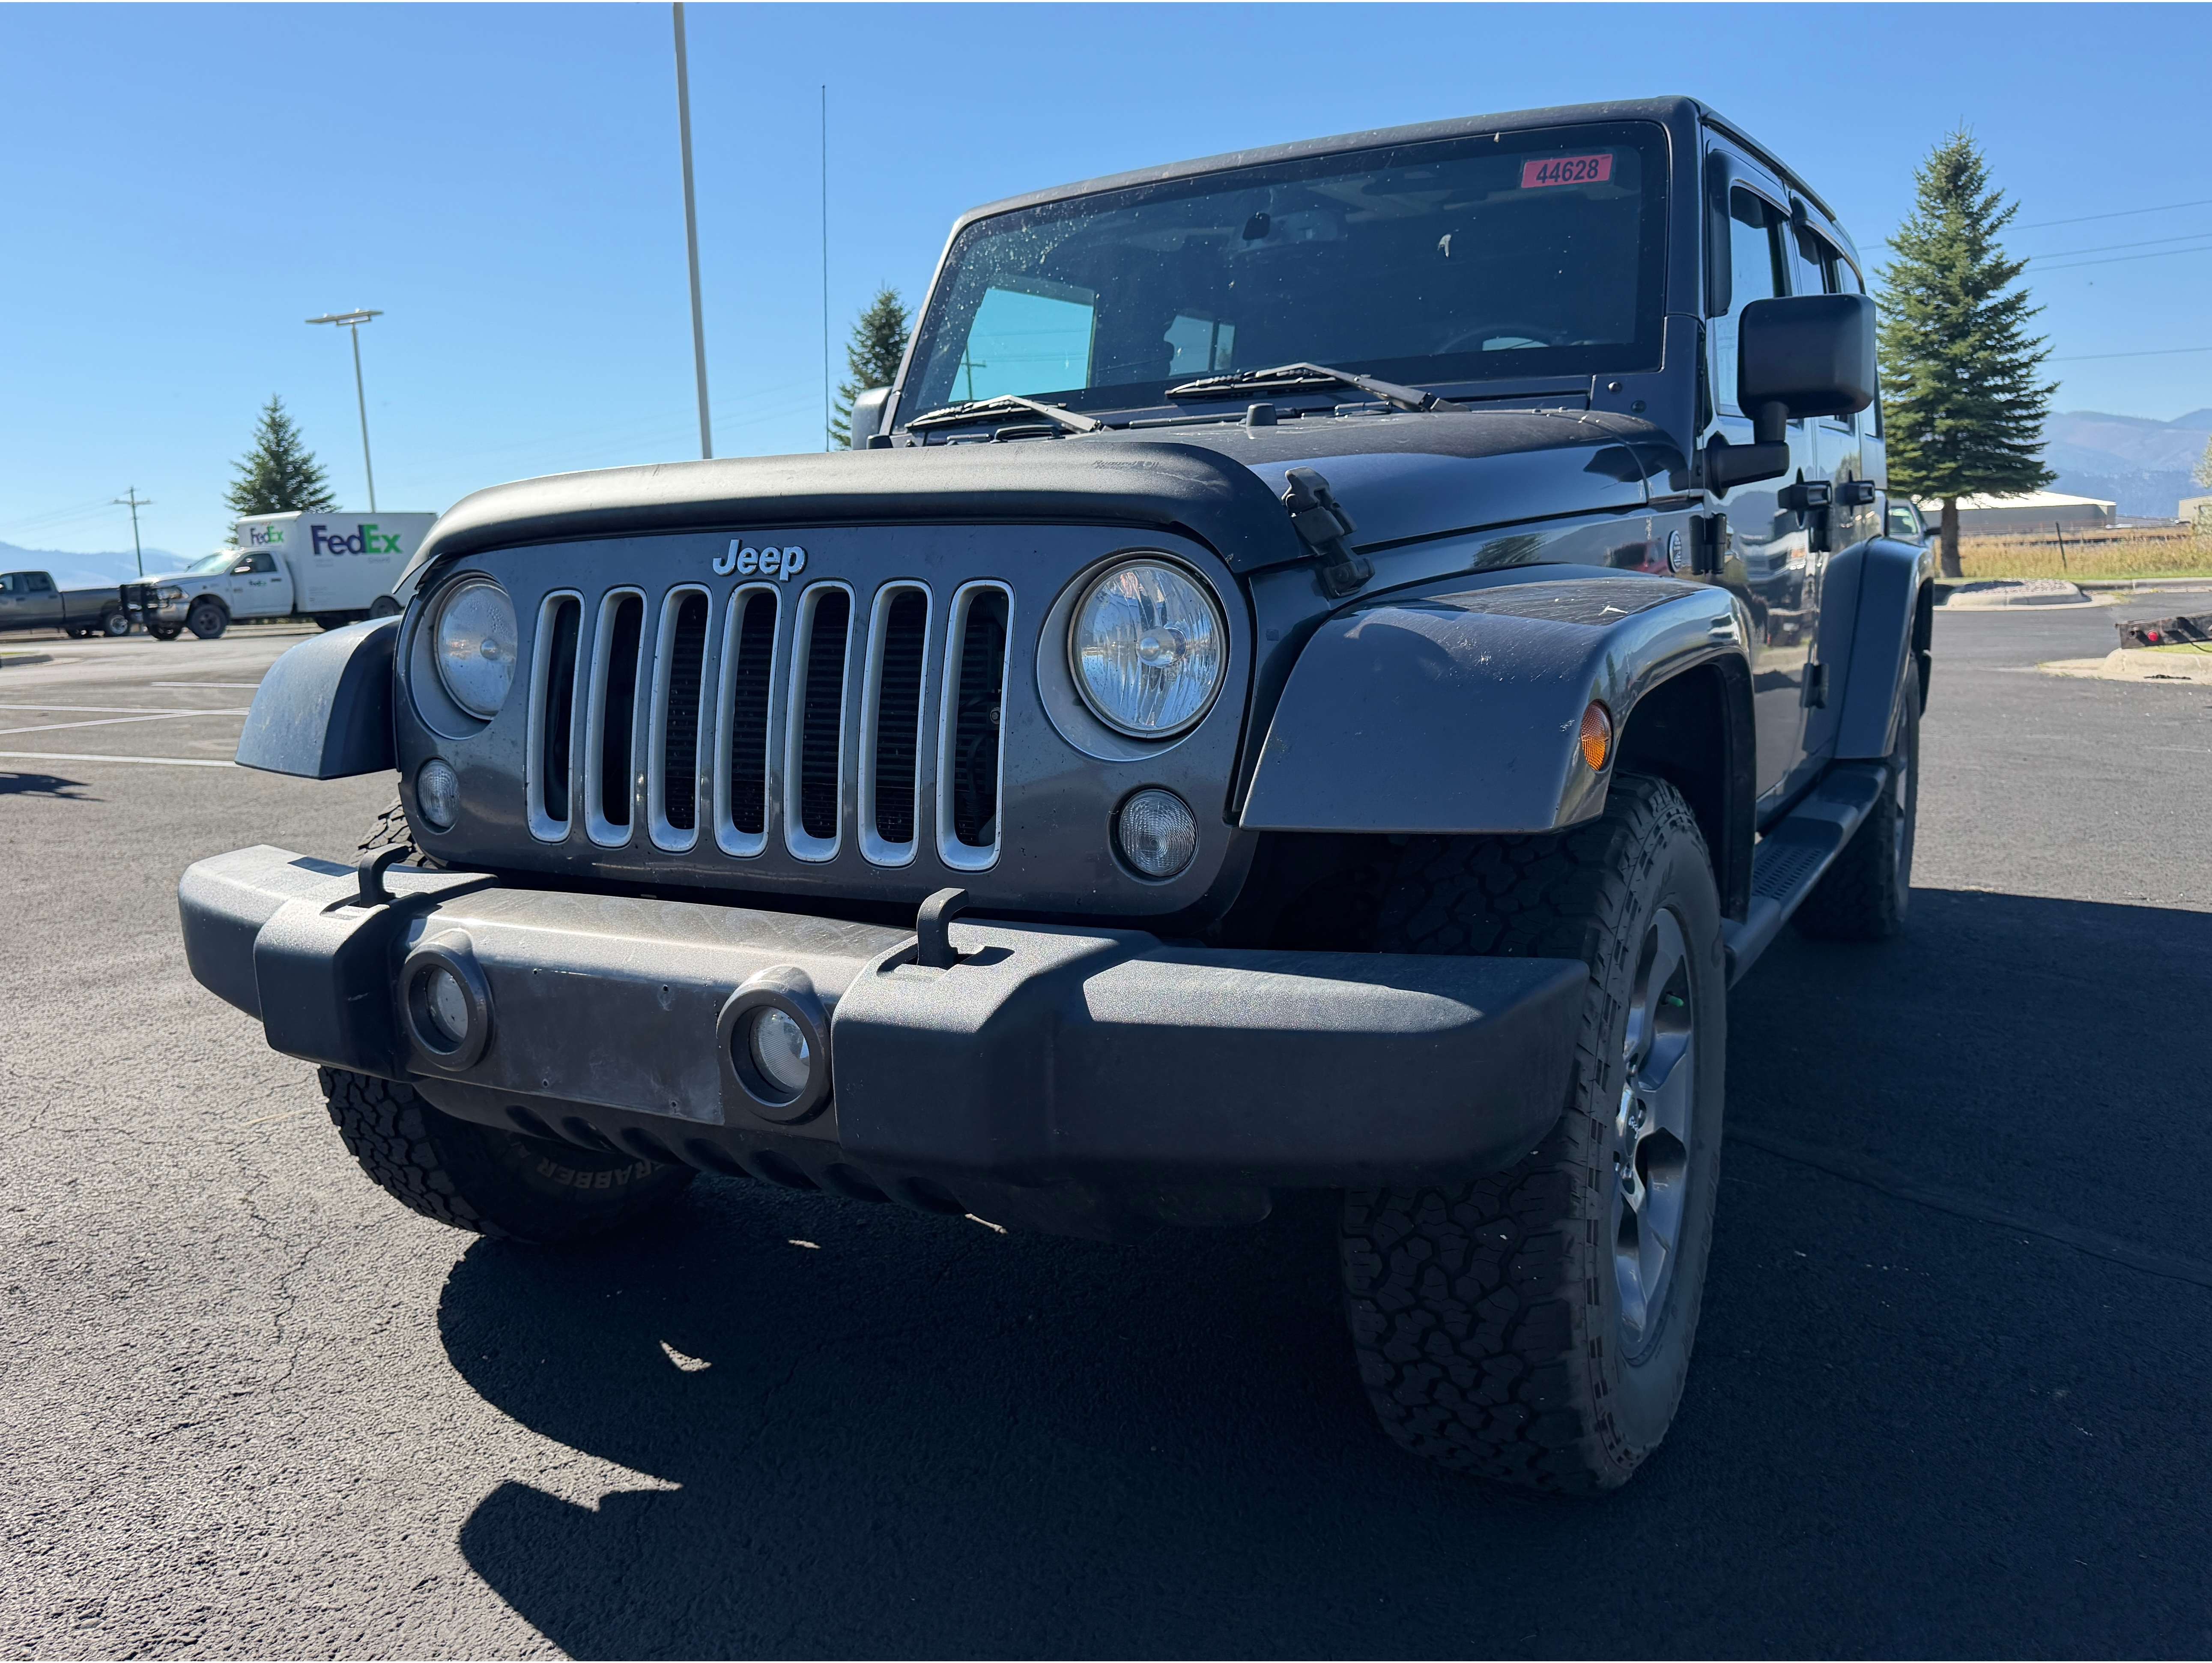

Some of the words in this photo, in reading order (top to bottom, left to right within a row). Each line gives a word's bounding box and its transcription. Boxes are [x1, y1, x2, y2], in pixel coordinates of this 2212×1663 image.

[1536, 159, 1599, 183] 44628
[250, 526, 284, 545] FedEx
[310, 524, 403, 555] FedEx
[713, 539, 807, 582] Jeep
